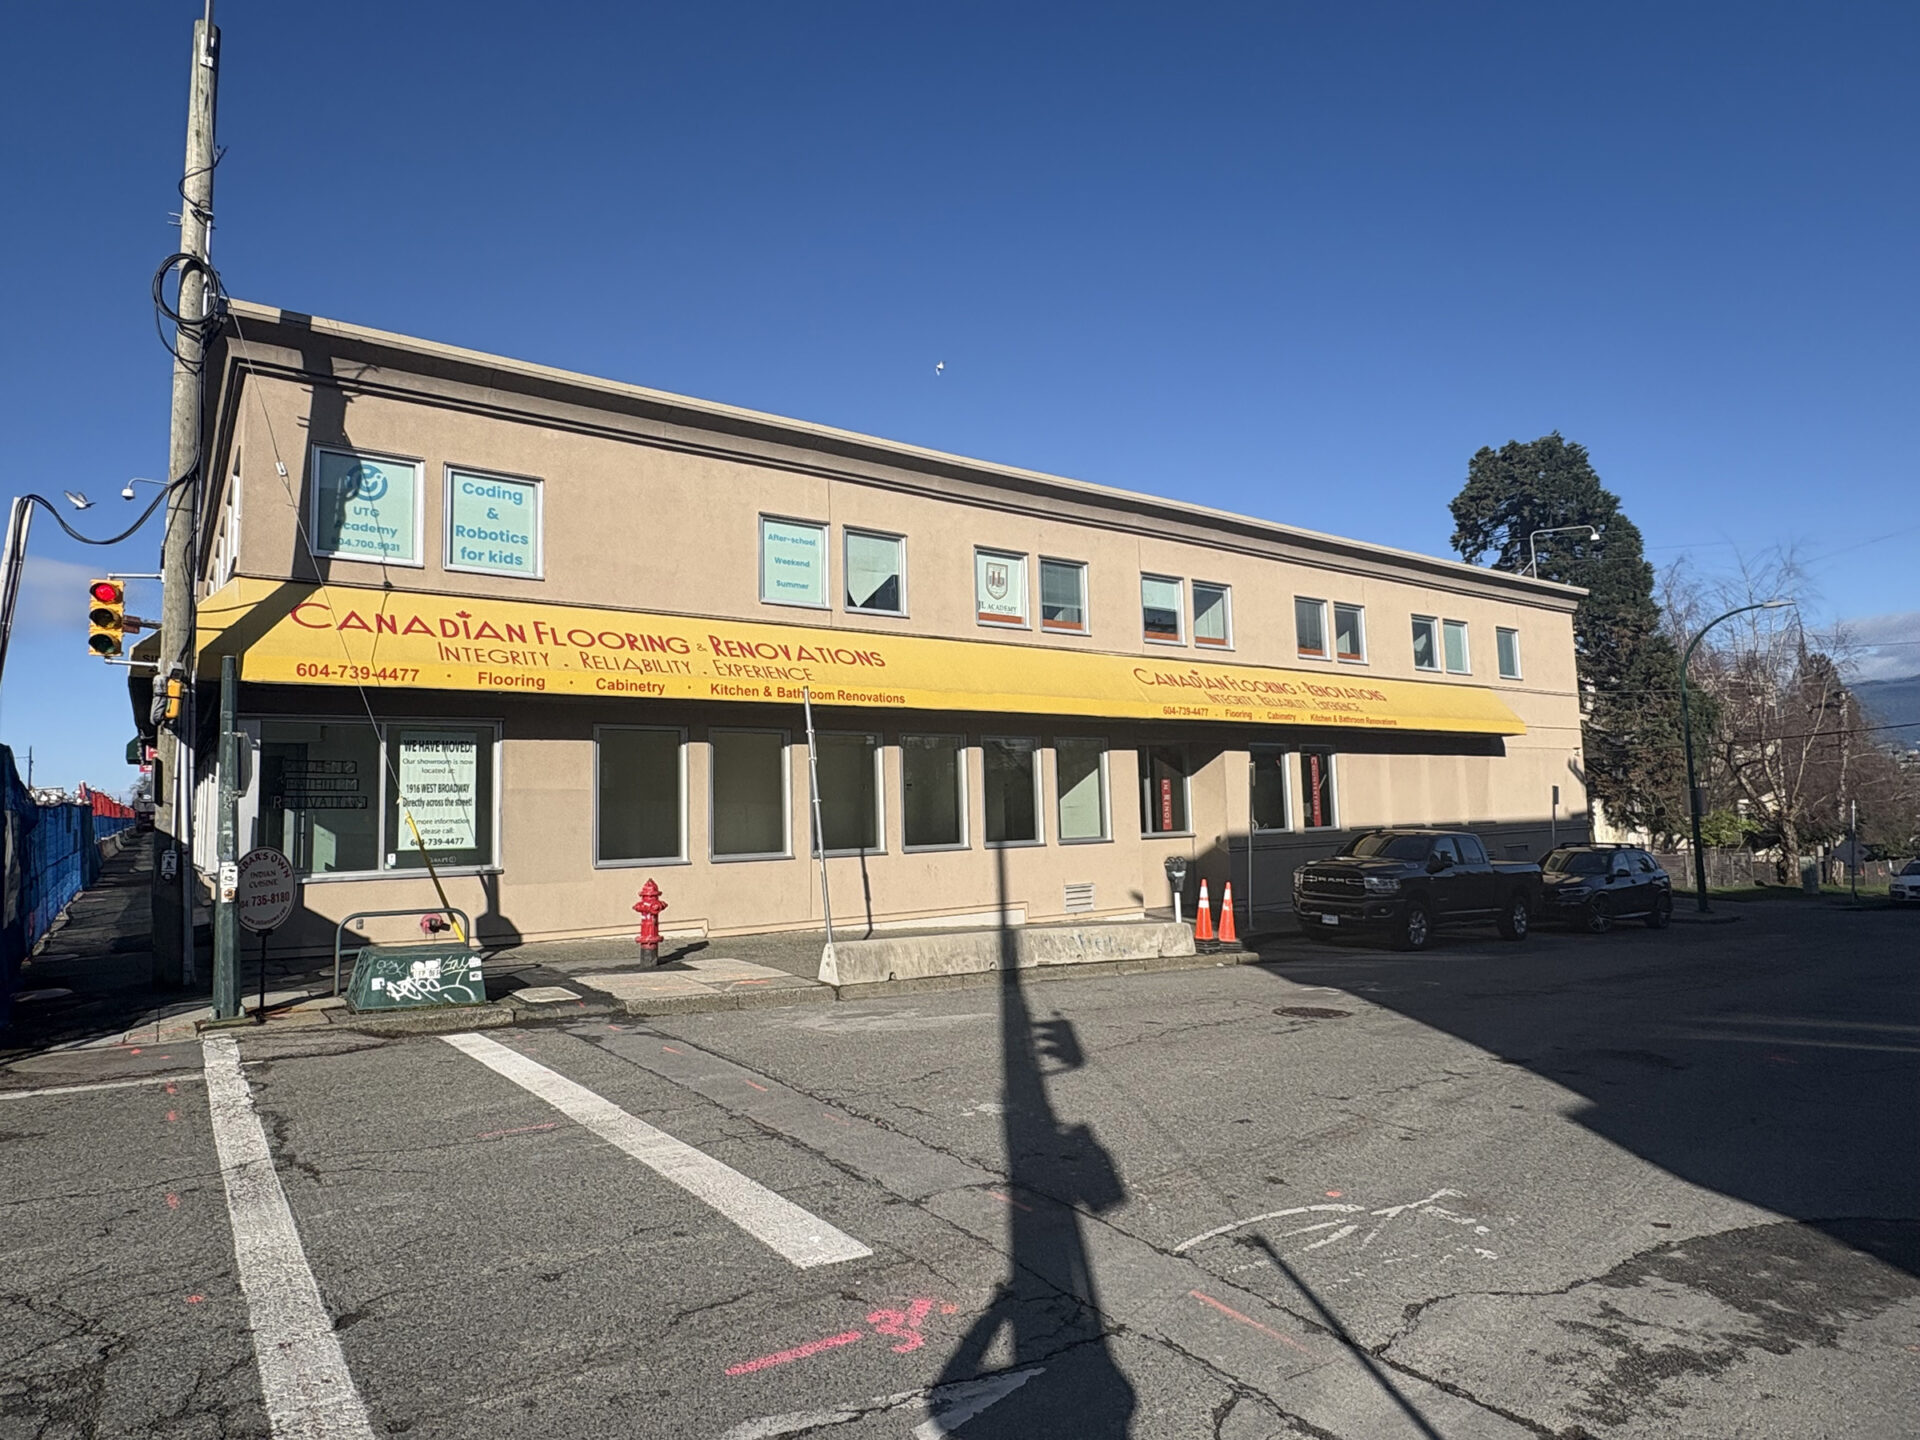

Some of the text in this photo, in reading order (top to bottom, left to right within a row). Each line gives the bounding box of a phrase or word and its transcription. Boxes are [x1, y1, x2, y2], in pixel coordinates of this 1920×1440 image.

[462, 482, 524, 505] Coding
[486, 507, 499, 520] &
[455, 525, 529, 546] Robotics
[768, 533, 816, 547] After-school
[460, 547, 523, 566] for kids
[774, 556, 810, 568] Weekend
[776, 579, 809, 590] Summer
[290, 602, 527, 644] CANADIAN
[533, 621, 691, 655] FLOORING
[708, 634, 886, 667] RENOVATIONS
[438, 641, 816, 682] INTEGRITY RELIABILITY EXPERIENCE
[296, 663, 906, 704] 604-739-4477 Flooring Cabinetry Kitchen & Bathoom Renovations
[1133, 668, 1230, 690] CANADIAN
[1223, 675, 1297, 695] FLOORING
[1301, 681, 1387, 702] RENOVATIONS
[1163, 706, 1209, 717] 604-739-4477
[1225, 708, 1252, 720] Flooring
[1267, 711, 1297, 722] Cabinetry
[1310, 713, 1332, 722] Kitchen
[1338, 715, 1365, 723] Bathroom
[1366, 717, 1397, 725] Renovations
[404, 740, 417, 752] WE
[419, 740, 440, 752] HAVE
[406, 783, 470, 793] 1916 WEST BROADWAY
[402, 797, 425, 809] Directly
[426, 799, 444, 807] across
[445, 797, 454, 807] the
[250, 869, 277, 879] INDIAN
[270, 853, 291, 878] OWN
